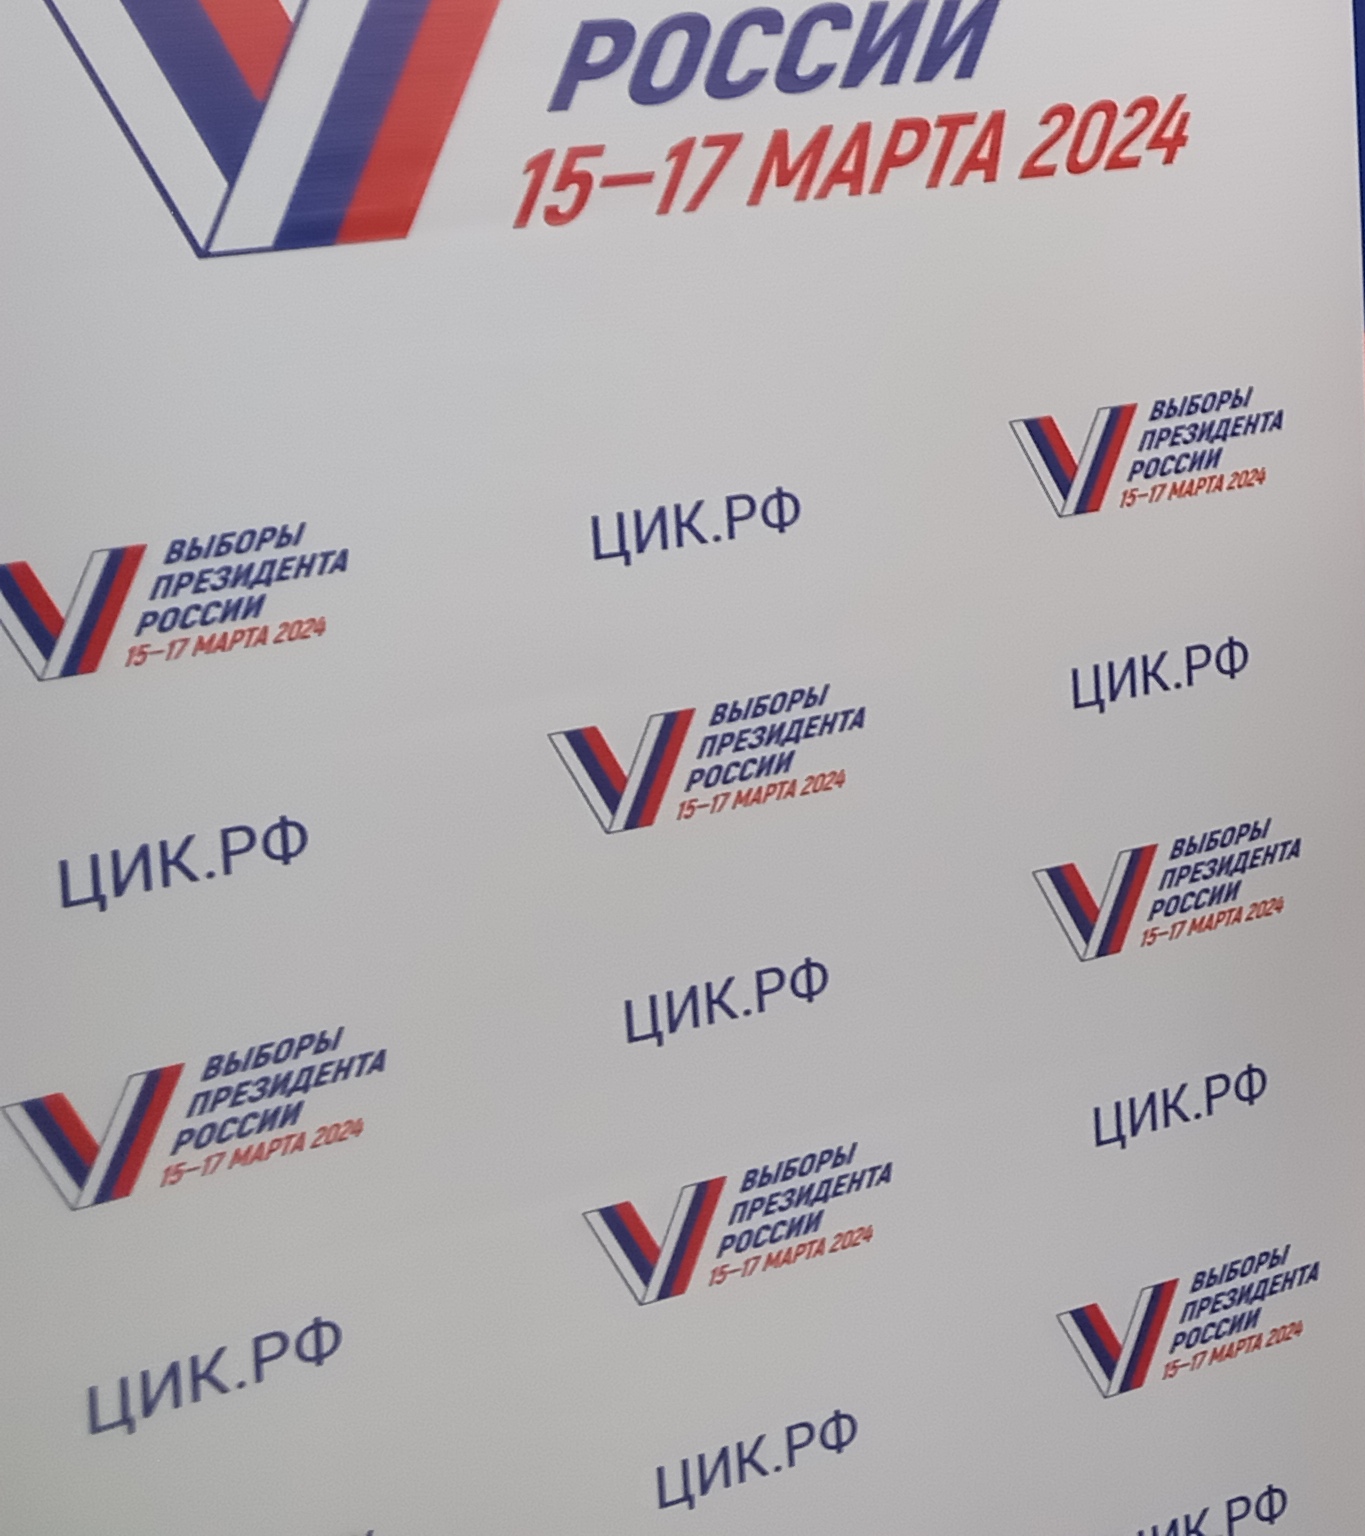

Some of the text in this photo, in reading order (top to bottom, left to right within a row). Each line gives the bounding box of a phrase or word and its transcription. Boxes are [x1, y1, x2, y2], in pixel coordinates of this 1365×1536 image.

[746, 107, 1006, 209] МАРТА
[1017, 92, 1191, 180] 2024
[1138, 409, 1284, 452] ПРЕЗИДЕНТА
[1148, 386, 1254, 421] ВЫБОРЫ
[1127, 447, 1223, 482] РОССИИ
[164, 521, 306, 565] ВЫБОРЫ
[591, 486, 801, 566] ЦИК.РФ
[149, 548, 349, 601] ПРЕЗИДЕНТА
[135, 594, 267, 637] РОССИИ
[1070, 635, 1249, 714] ЦИК.РФ
[709, 683, 830, 726] ВЫБОРЫ
[696, 706, 866, 760] ПРЕЗИДЕНТА
[684, 750, 796, 792] РОССИИ
[57, 814, 310, 913] ЦИК.РФ
[1158, 837, 1301, 891] ПРЕЗИДЕНТА
[1169, 817, 1272, 861] ВЫБОРЫ
[1147, 879, 1242, 922] РОССИИ
[624, 957, 830, 1047] ЦИК.РФ
[200, 1026, 345, 1082] ВЫБОРЫ
[186, 1048, 387, 1118] ПРЕЗИДЕНТА
[1093, 1063, 1269, 1150] ЦИК.РФ
[169, 1100, 305, 1156] РОССИИ
[728, 1162, 893, 1226] ПРЕЗИДЕНТА
[739, 1142, 858, 1194] ВЫБОРЫ
[716, 1210, 825, 1259] РОССИИ
[1179, 1261, 1320, 1324] ПРЕЗИДЕНТА
[1189, 1244, 1291, 1294] ВЫБОРЫ
[1169, 1307, 1262, 1354] РОССИИ
[87, 1316, 345, 1436] ЦИК.РФ
[656, 1408, 860, 1511] ЦИК.РФ
